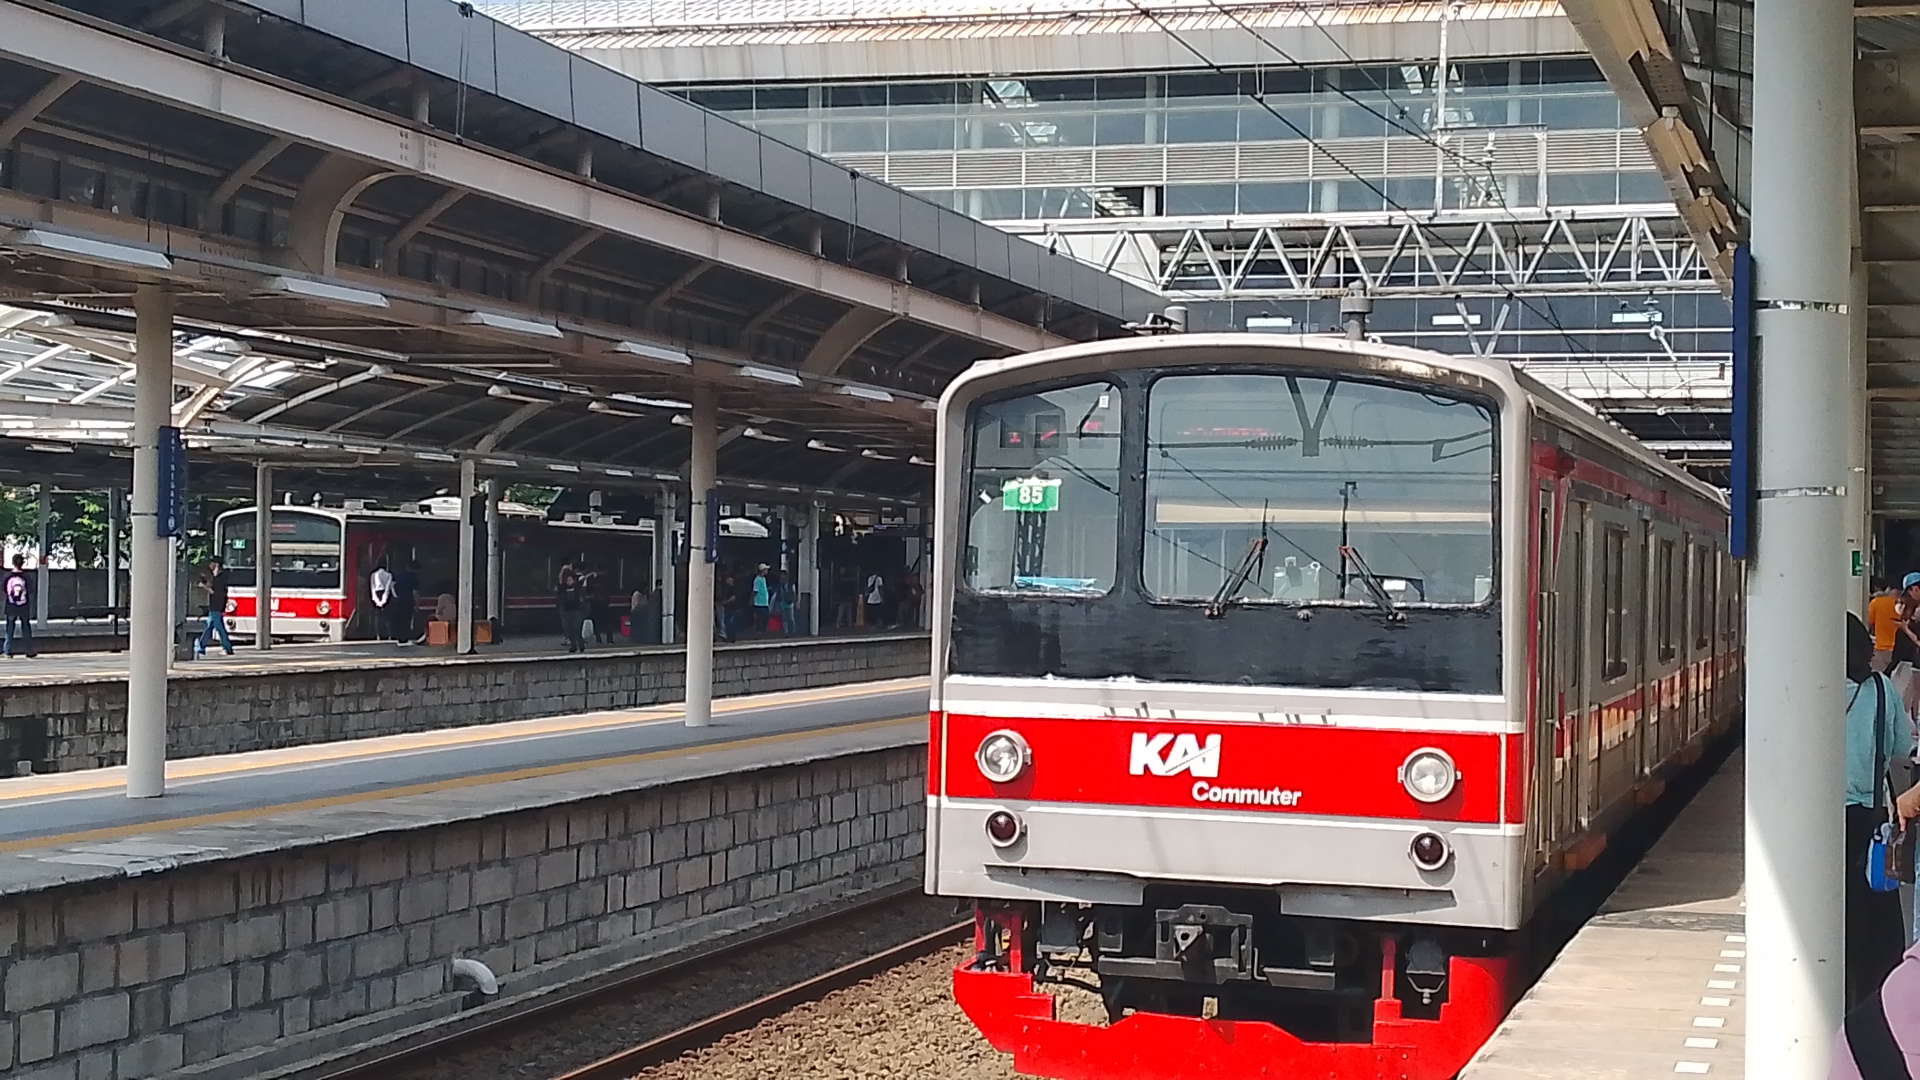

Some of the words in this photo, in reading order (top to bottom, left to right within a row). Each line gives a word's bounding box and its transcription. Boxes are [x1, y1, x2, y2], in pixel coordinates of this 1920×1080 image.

[1018, 485, 1043, 504] 85
[765, 515, 772, 524] 6
[1129, 732, 1222, 778] KAI
[1191, 780, 1302, 806] Commuter
